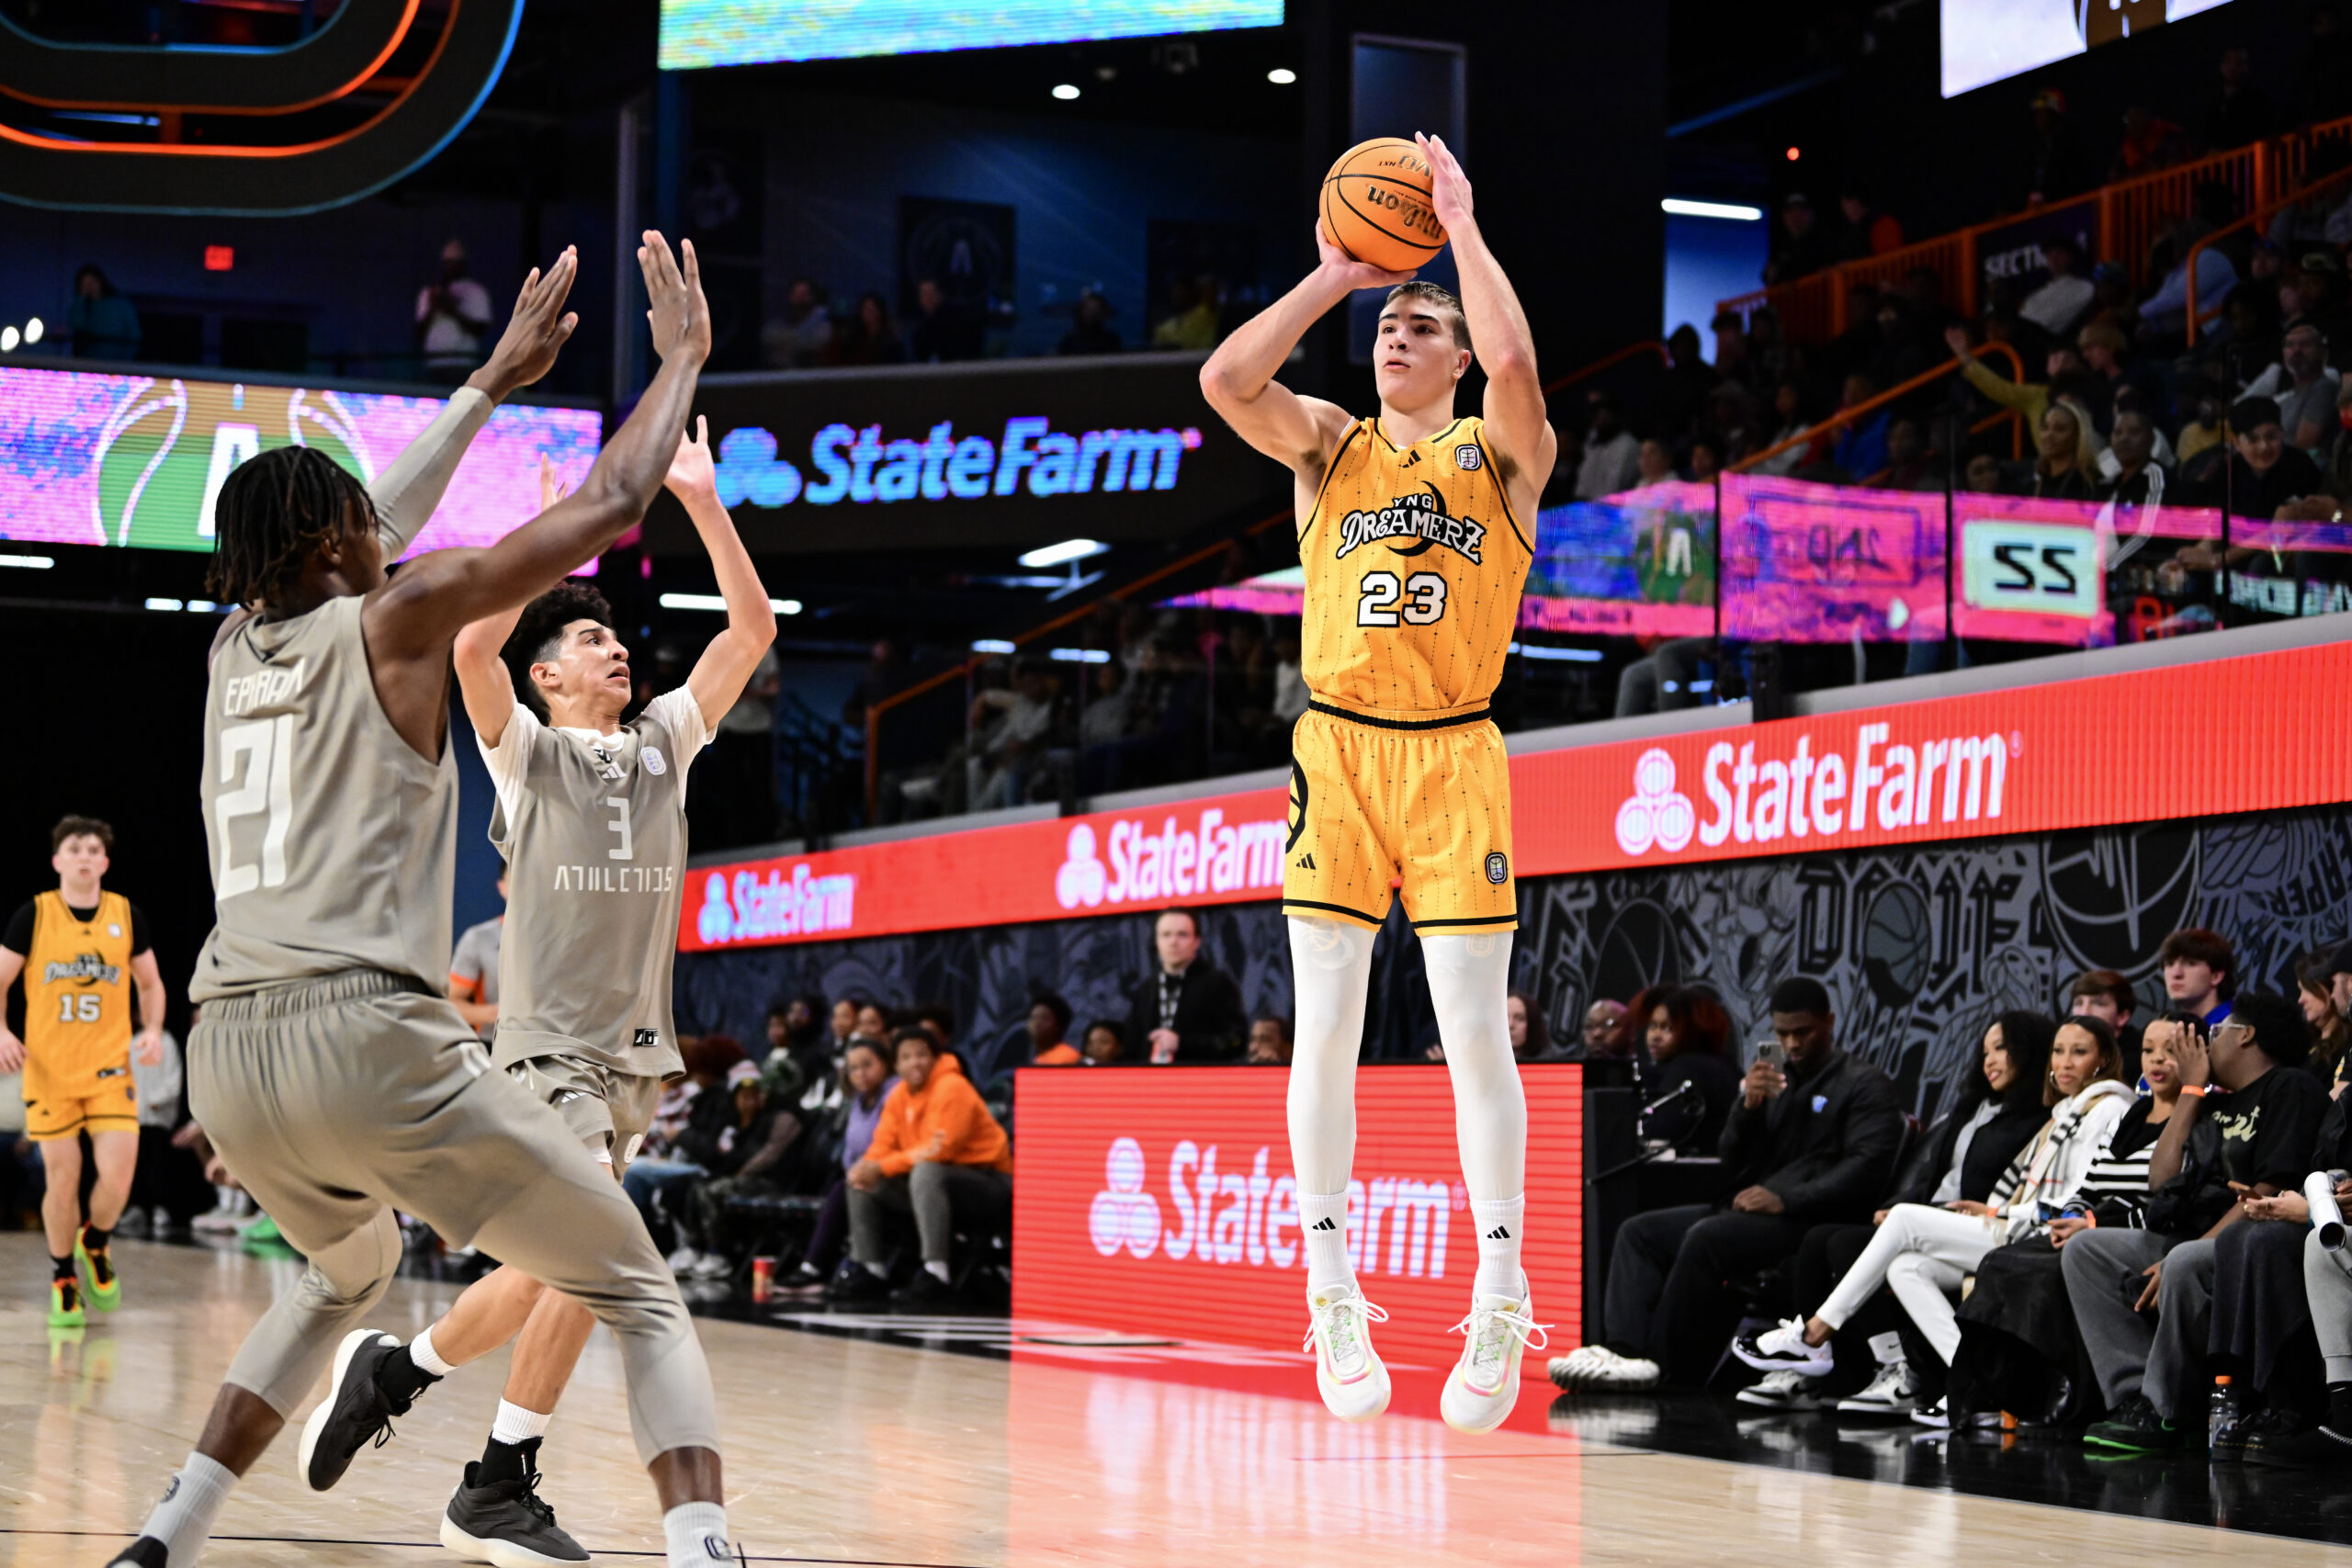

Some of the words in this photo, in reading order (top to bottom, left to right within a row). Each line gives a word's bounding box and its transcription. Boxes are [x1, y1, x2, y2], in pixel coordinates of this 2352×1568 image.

[1397, 155, 1431, 177] VO
[1391, 493, 1434, 510] YNG
[1336, 509, 1487, 566] DREAMERZ
[1357, 570, 1448, 627] 23
[215, 713, 294, 902] 21
[606, 796, 633, 860] 3
[60, 994, 101, 1022] 15
